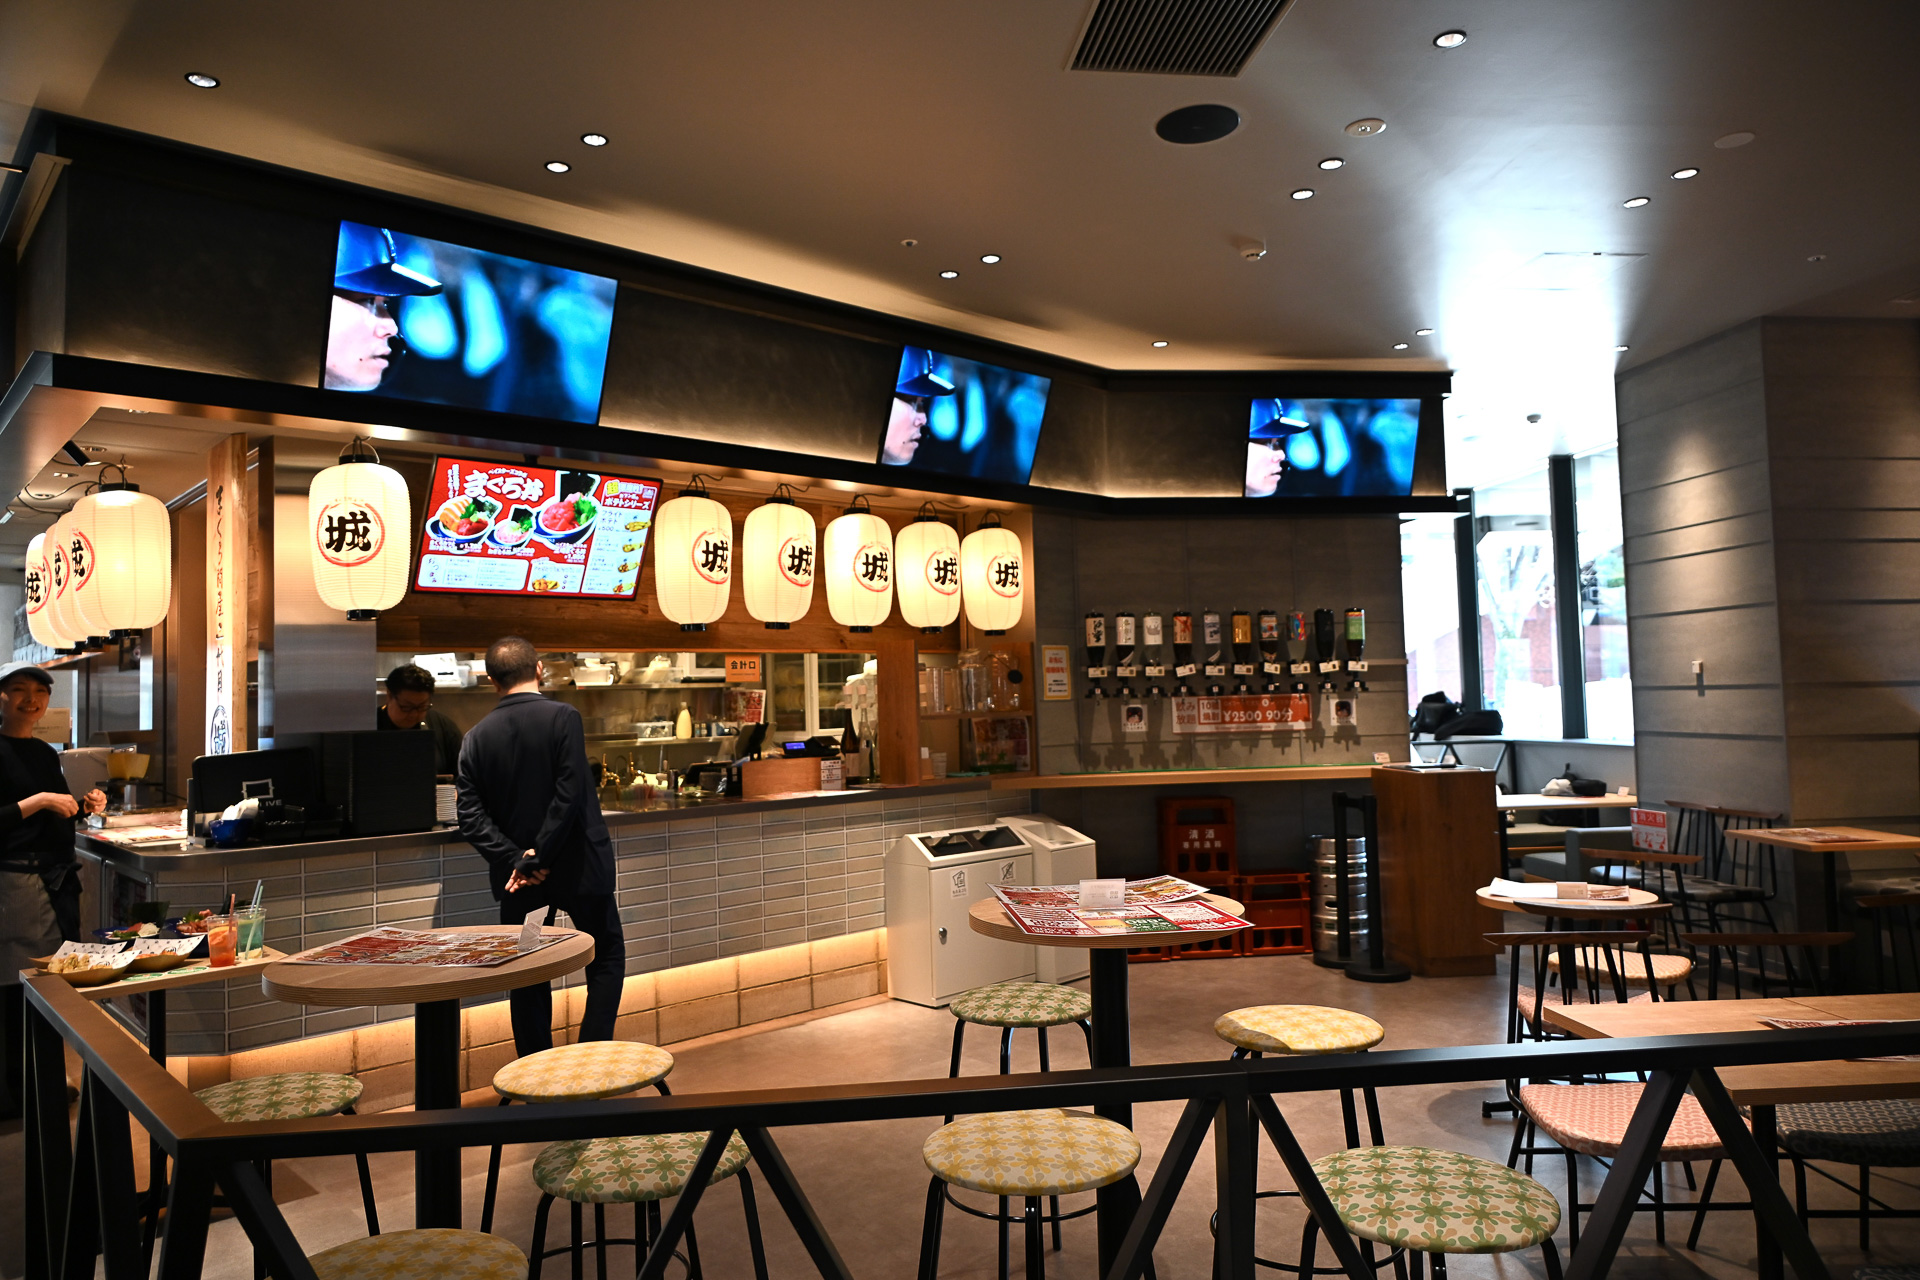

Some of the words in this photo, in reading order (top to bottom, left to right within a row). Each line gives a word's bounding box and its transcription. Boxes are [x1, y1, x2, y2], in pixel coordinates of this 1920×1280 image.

[463, 469, 544, 502] まぐろ丼
[604, 498, 651, 510] ポテトシリーズ
[325, 510, 372, 552] 城
[701, 539, 728, 575] 城
[788, 545, 813, 577] 城
[862, 552, 889, 582] 城
[934, 557, 958, 586] 城
[995, 561, 1020, 588] 城
[731, 660, 756, 669] 会計口
[1176, 701, 1196, 711] 飲み
[1223, 710, 1262, 722] ¥2500
[1266, 708, 1293, 721] 90分
[1176, 714, 1197, 725] 放題
[1639, 812, 1664, 824] 消火器
[1189, 829, 1215, 839] 清酒
